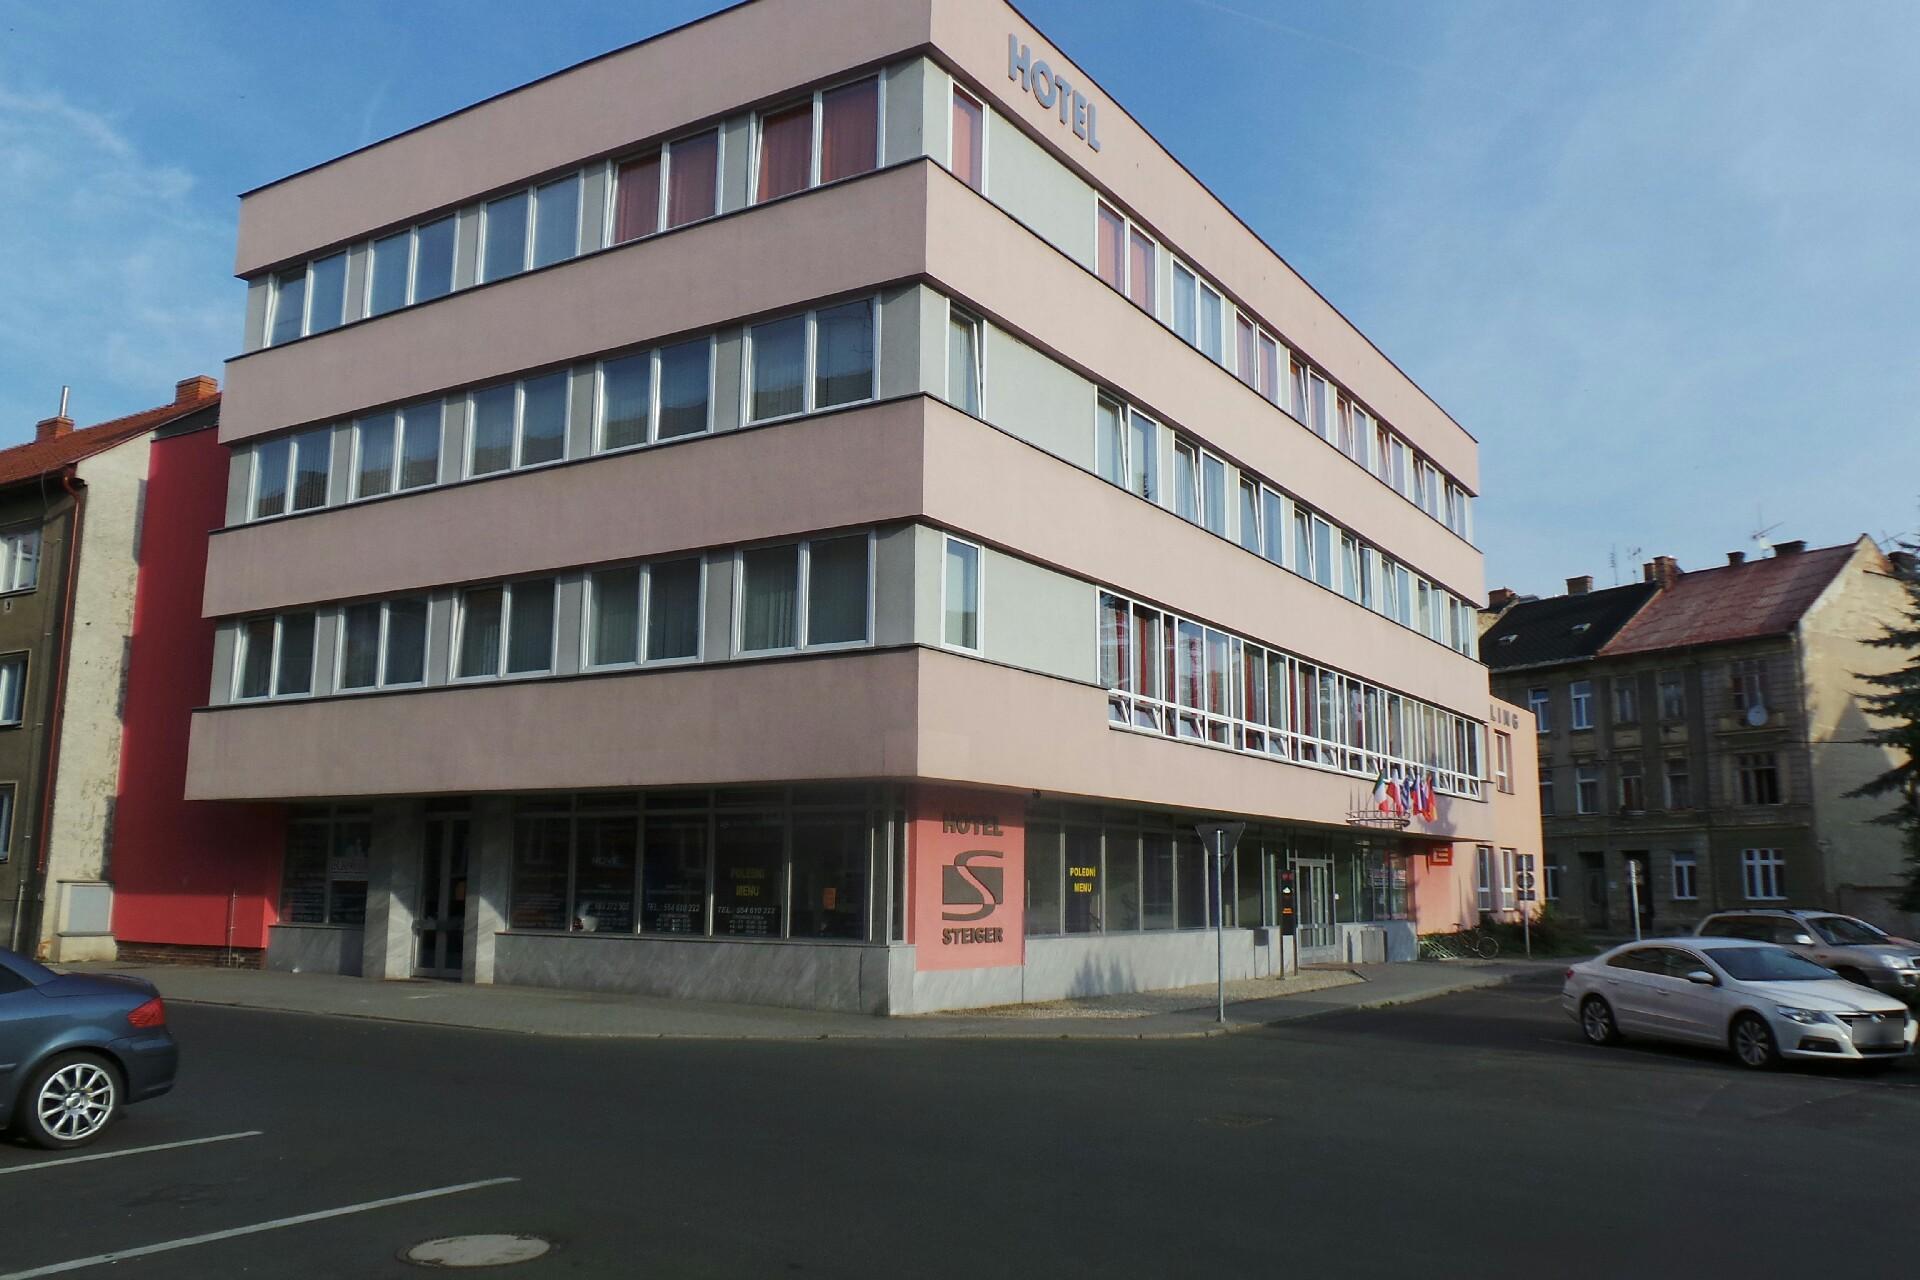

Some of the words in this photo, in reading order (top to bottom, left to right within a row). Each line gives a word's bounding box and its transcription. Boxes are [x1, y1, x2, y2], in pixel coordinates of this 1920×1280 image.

[1008, 33, 1101, 153] HOTEL
[942, 814, 1004, 837] HOTEL
[735, 885, 760, 897] MENU
[1073, 882, 1092, 893] MENU
[941, 926, 1004, 945] STEIGER
